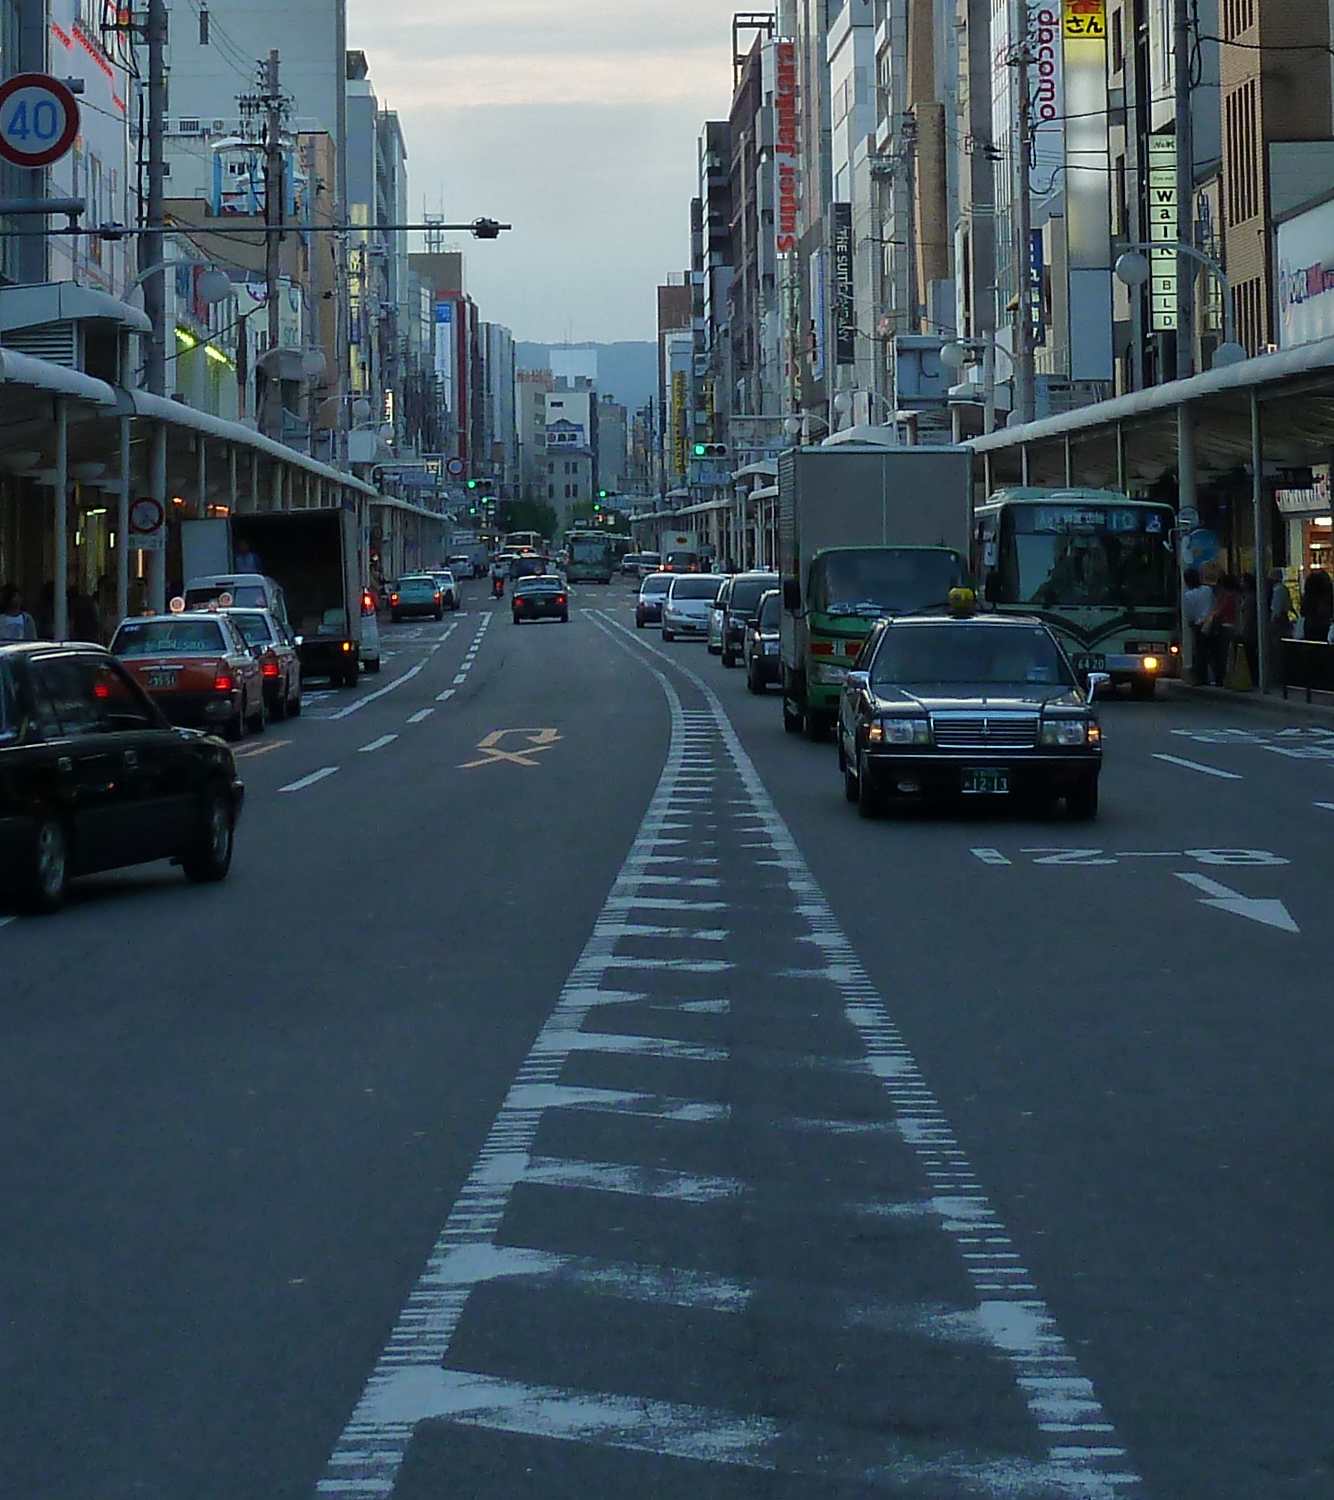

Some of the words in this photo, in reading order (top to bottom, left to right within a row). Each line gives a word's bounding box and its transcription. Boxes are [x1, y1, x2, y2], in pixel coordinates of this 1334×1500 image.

[1065, 15, 1103, 34] さん
[1037, 9, 1059, 120] docomo
[6, 99, 59, 141] 40
[776, 162, 796, 252] Super
